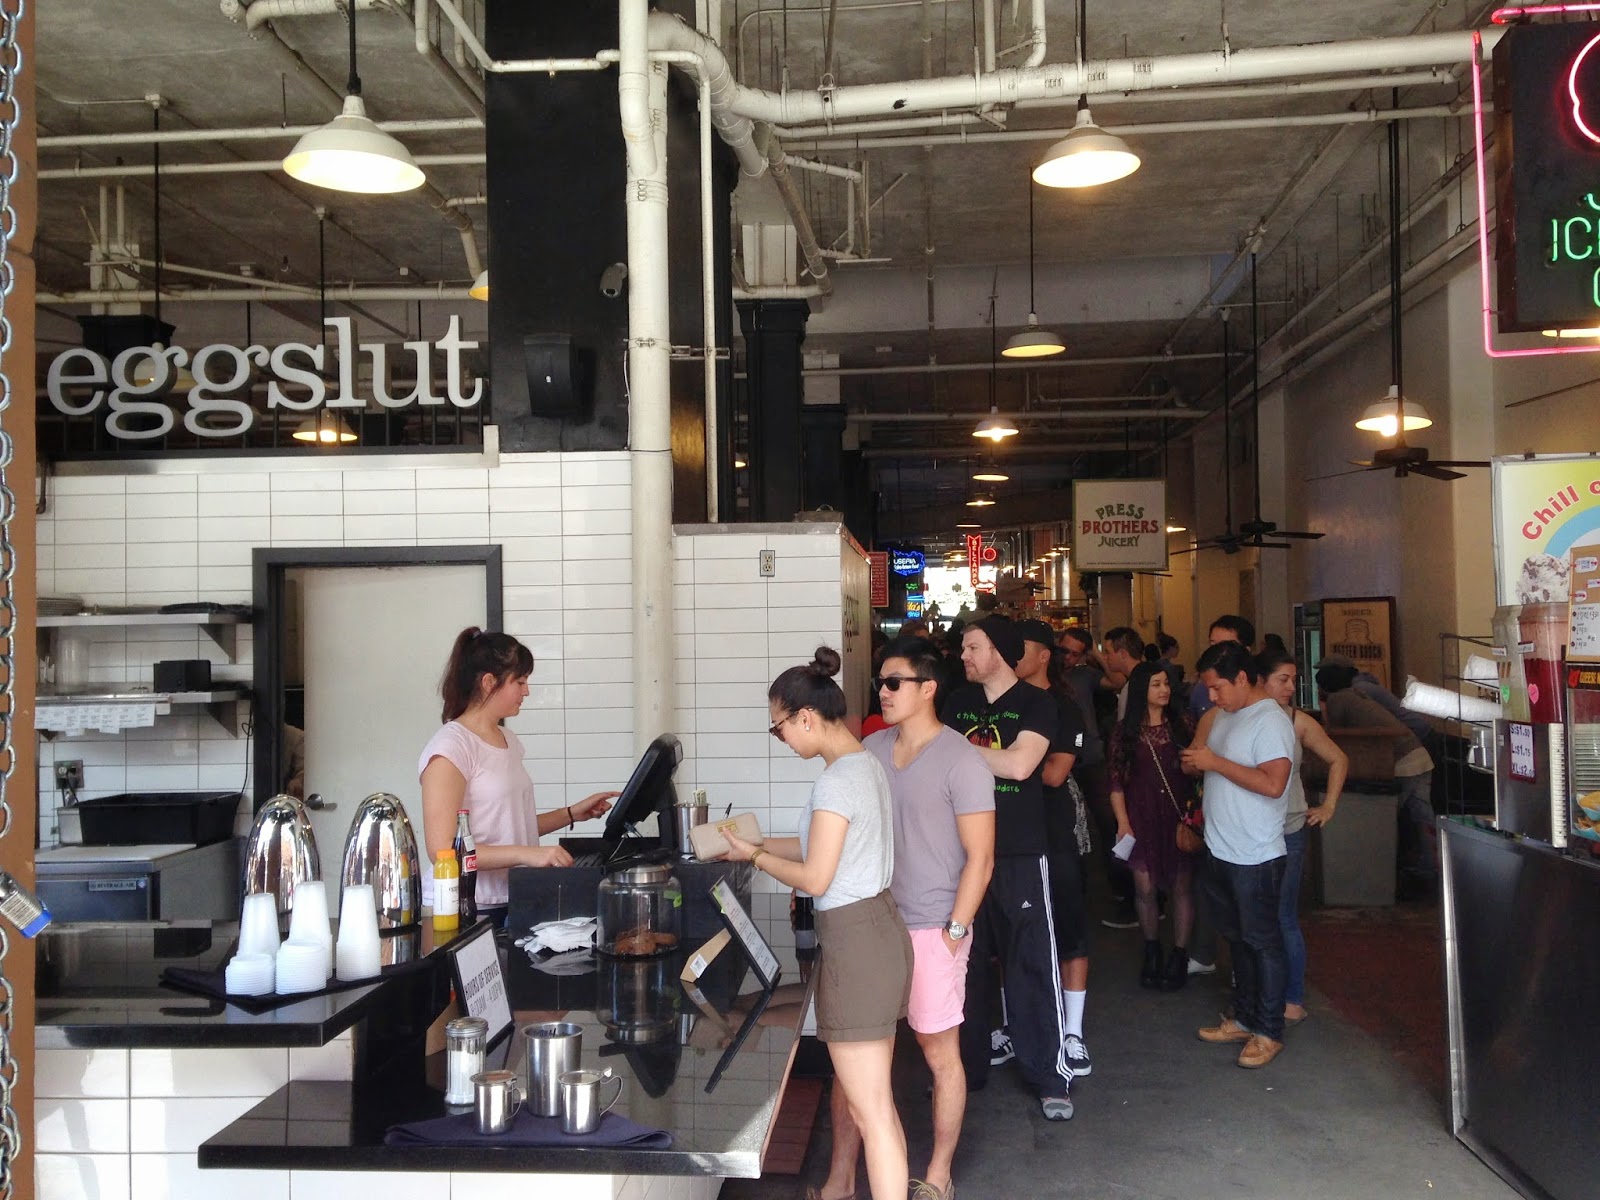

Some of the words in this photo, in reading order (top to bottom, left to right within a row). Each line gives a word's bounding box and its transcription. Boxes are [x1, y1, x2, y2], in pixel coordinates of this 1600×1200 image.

[1551, 216, 1600, 262] IC
[47, 314, 484, 440] eggslut
[1095, 503, 1145, 520] PRESS
[1521, 485, 1580, 540] Chill
[1082, 520, 1159, 534] BROTHERS
[1097, 534, 1140, 547] JUICERY
[463, 976, 480, 1001] HOURS
